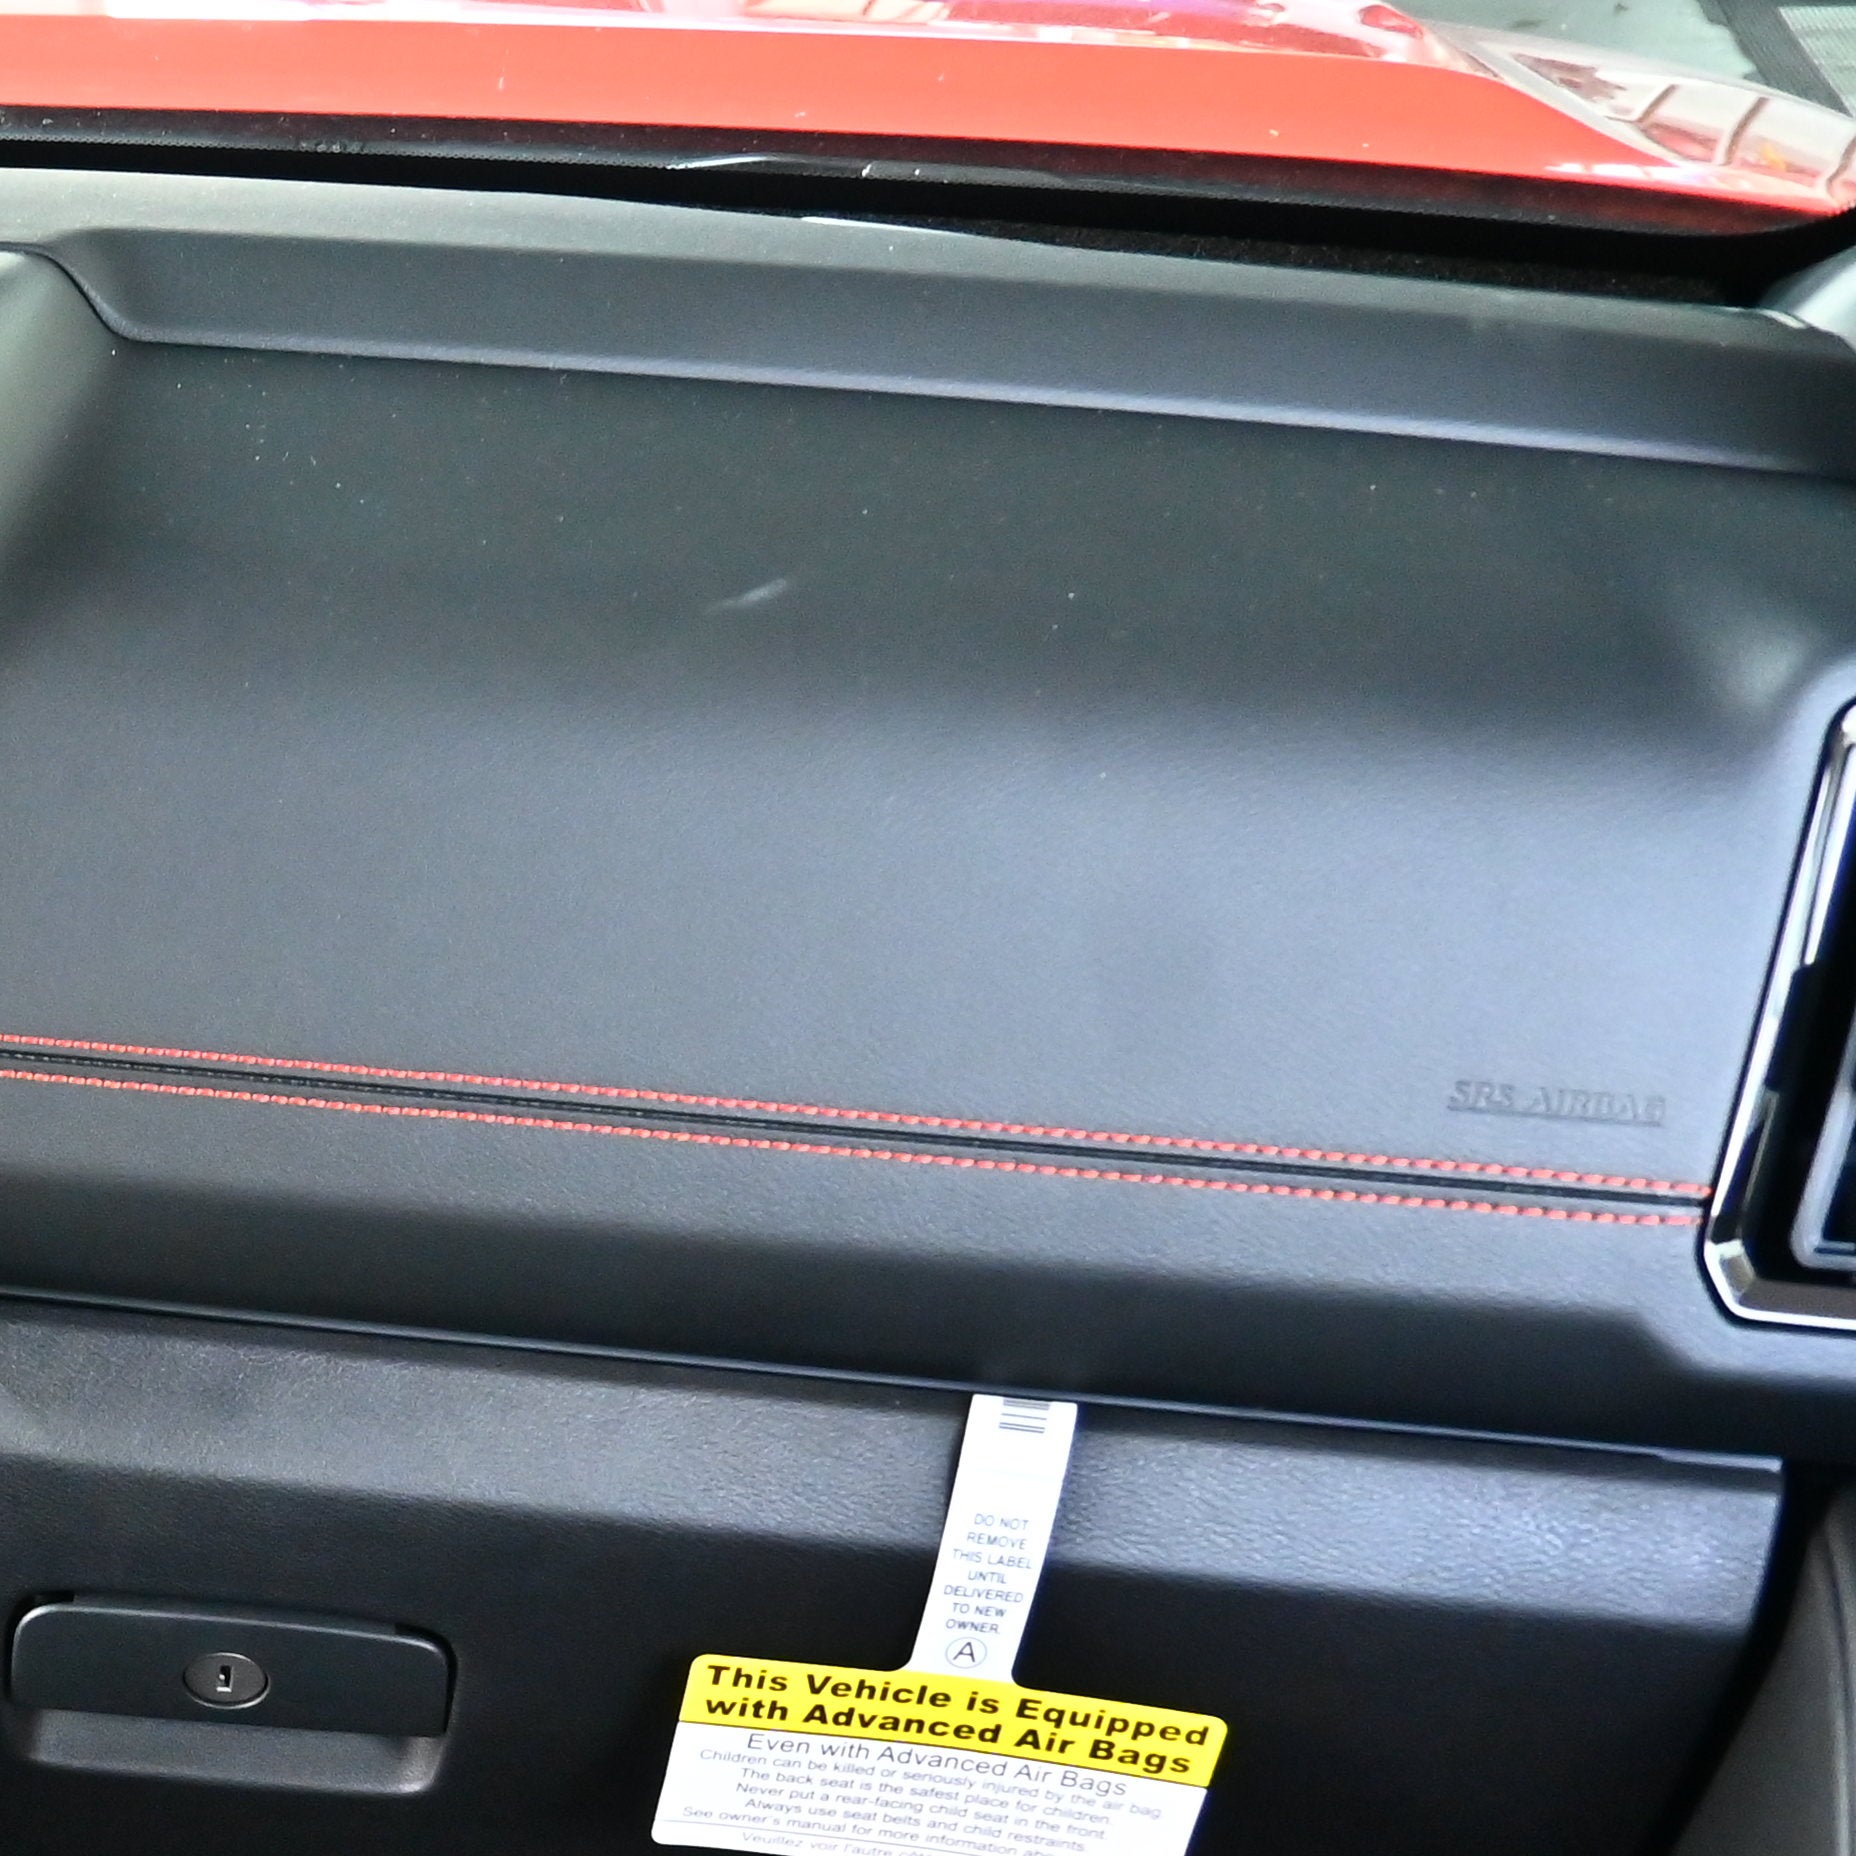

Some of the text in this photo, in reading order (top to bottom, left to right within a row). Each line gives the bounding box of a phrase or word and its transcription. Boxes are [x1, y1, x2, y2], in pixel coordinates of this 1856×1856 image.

[1453, 1080, 1667, 1123] SRS AIRBAG
[973, 1512, 1030, 1532] DO NOT
[966, 1531, 1027, 1551] REMOVE
[952, 1548, 1032, 1570] THIS LABEL
[968, 1570, 1007, 1585] UNTIL
[943, 1584, 1024, 1604] DELIVERED
[952, 1601, 1008, 1618] TO NEW
[953, 1641, 976, 1663] A
[706, 1664, 1210, 1747] This Vehicle is Equipped
[705, 1696, 1191, 1775] with Advanced Air Bags
[699, 1748, 1124, 1811] Children can be killed or seriously injured by the air
[747, 1732, 1128, 1797] Even with Advanced Air Bags
[741, 1767, 771, 1781] The
[775, 1769, 814, 1784] back
[819, 1777, 855, 1790] seat
[878, 1781, 904, 1794] the
[909, 1785, 960, 1800] safest
[964, 1791, 1010, 1811] place
[1014, 1798, 1037, 1813] for
[736, 1782, 785, 1796] Never
[789, 1788, 816, 1801] put
[835, 1791, 924, 1813] rear-facing
[929, 1804, 969, 1818] child
[973, 1809, 1009, 1824] seat
[1034, 1817, 1061, 1833] the
